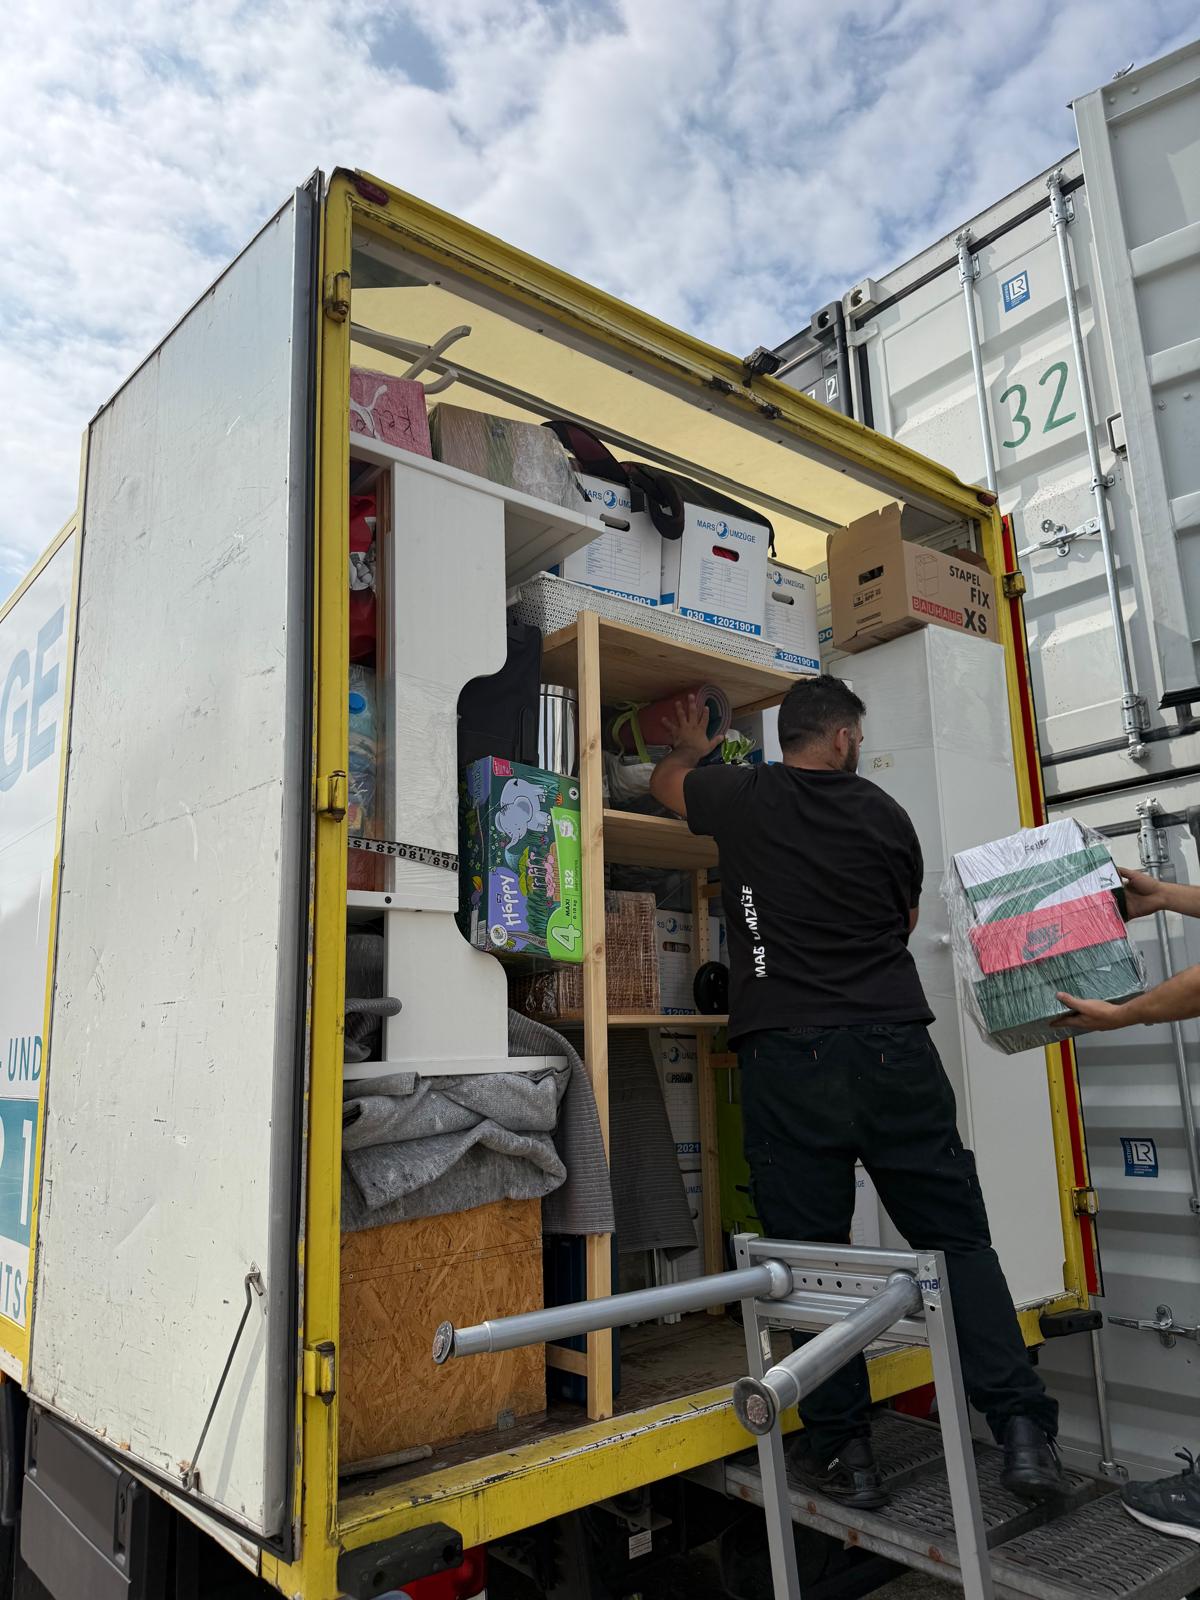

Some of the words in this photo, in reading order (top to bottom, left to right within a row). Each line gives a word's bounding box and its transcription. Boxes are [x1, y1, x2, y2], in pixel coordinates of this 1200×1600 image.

[827, 378, 837, 400] 2
[999, 361, 1077, 449] 32
[697, 519, 716, 532] MARS
[729, 529, 756, 544] UMZÜGE
[949, 565, 981, 587] STAPEL
[912, 598, 963, 624] BAUHAUS
[970, 588, 991, 610] FIX
[687, 610, 705, 622] 030
[712, 615, 756, 633] 12021901
[963, 608, 987, 634] XS
[779, 652, 815, 667] 12021901
[0, 604, 65, 792] GE
[347, 839, 459, 871] 068/1804815
[564, 869, 574, 889] 132
[551, 923, 582, 951] 4
[8, 1036, 43, 1082] UND
